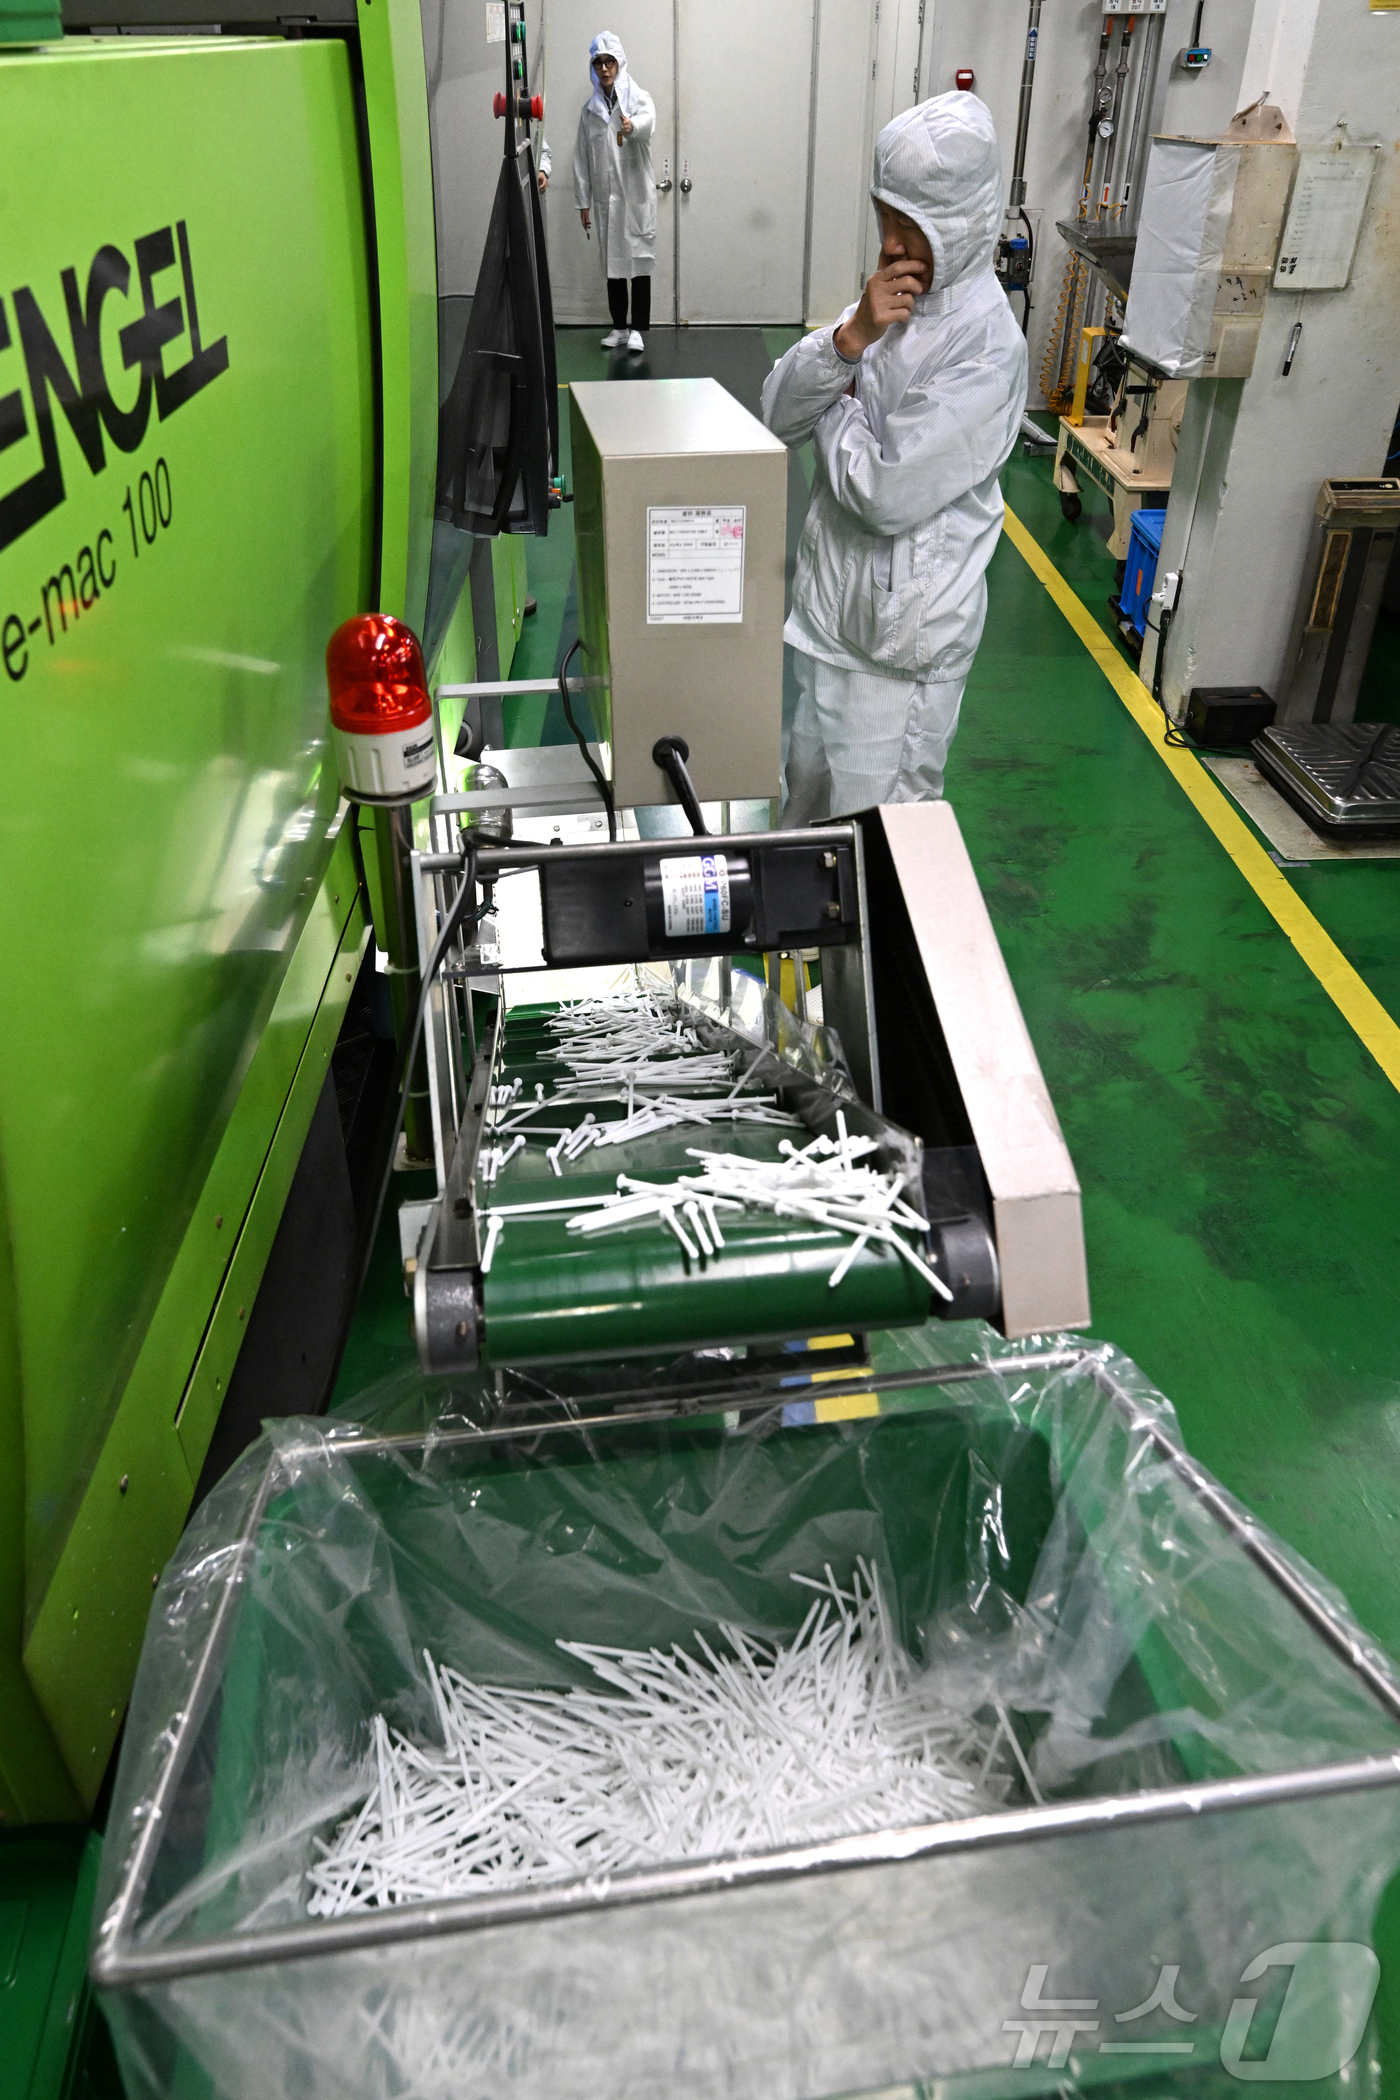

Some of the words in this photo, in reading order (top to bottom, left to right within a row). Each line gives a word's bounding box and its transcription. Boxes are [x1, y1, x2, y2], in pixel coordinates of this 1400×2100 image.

[2, 528, 116, 682] e-mac
[122, 457, 172, 558] 100
[702, 857, 718, 891] GGM
